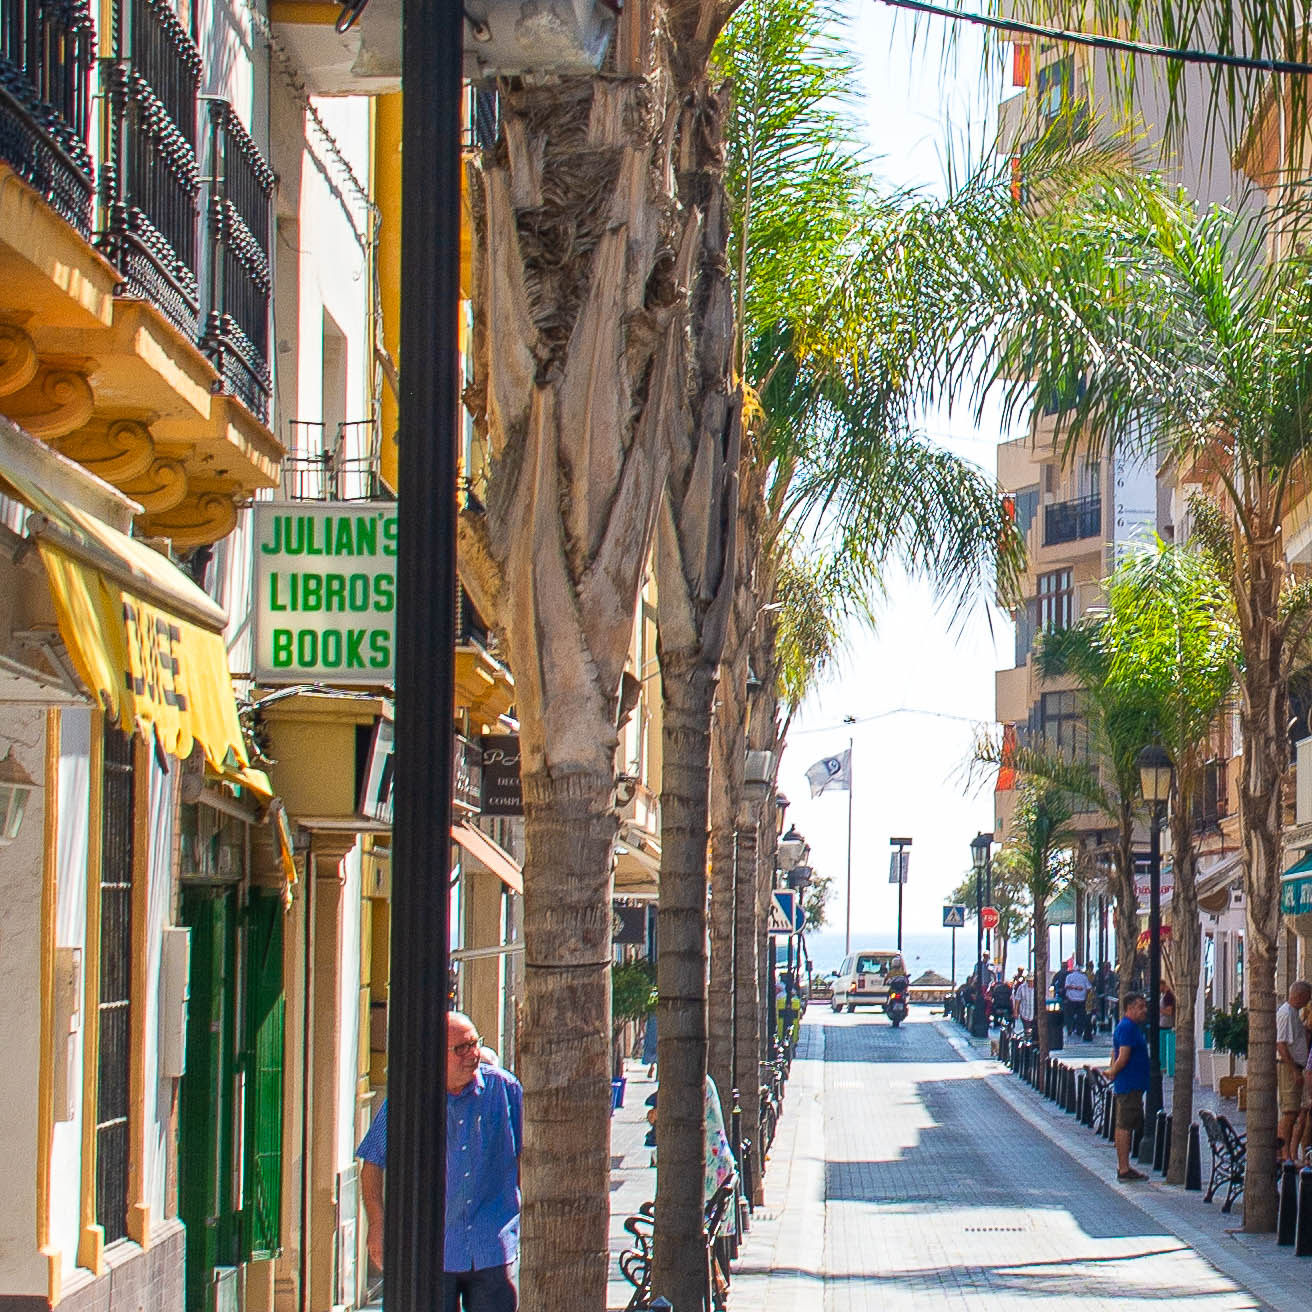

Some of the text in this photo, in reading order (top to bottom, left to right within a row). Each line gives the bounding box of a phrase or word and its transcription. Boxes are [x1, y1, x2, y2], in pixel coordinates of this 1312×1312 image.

[261, 512, 398, 556] JULIAN'S
[270, 572, 395, 613] LIBROS
[272, 628, 391, 669] BOOKS
